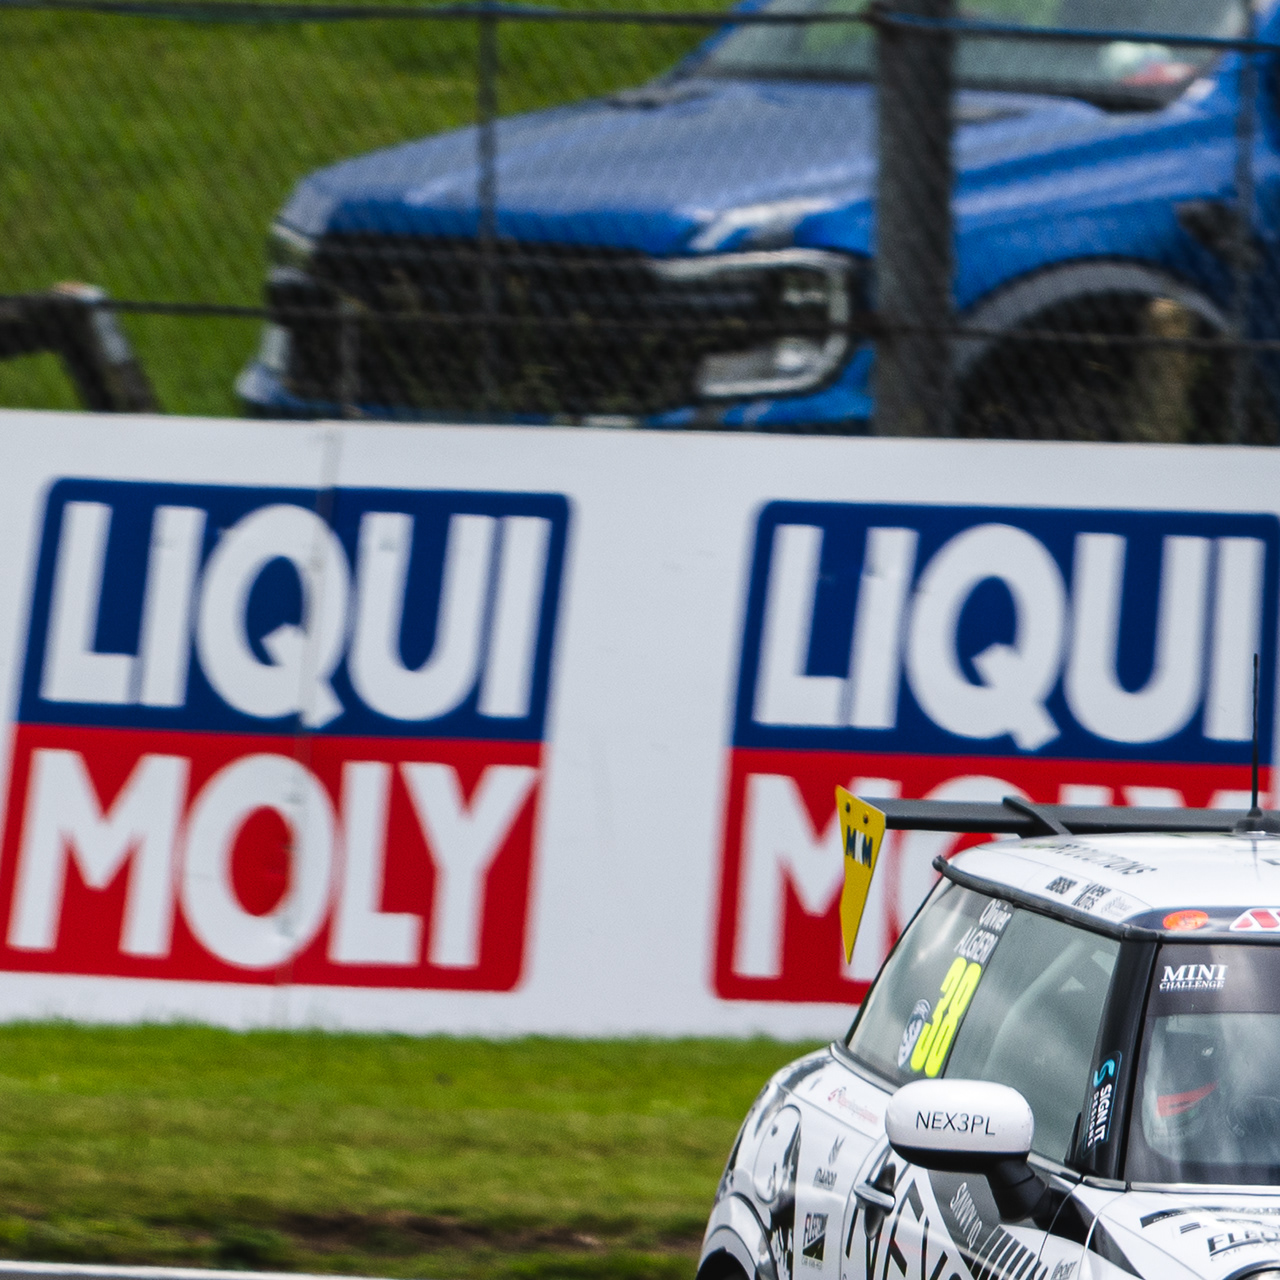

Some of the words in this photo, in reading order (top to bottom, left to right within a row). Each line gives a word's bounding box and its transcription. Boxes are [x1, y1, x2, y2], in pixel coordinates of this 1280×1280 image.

[40, 501, 551, 728] LIQUI
[755, 523, 1262, 750] LIQUI
[5, 748, 539, 971] MOLY
[1159, 980, 1225, 991] CHALLENGE
[1161, 964, 1228, 982] MINI
[910, 956, 982, 1078] 38
[915, 1110, 996, 1136] NEX3PL
[1096, 1083, 1112, 1125] SIGN
